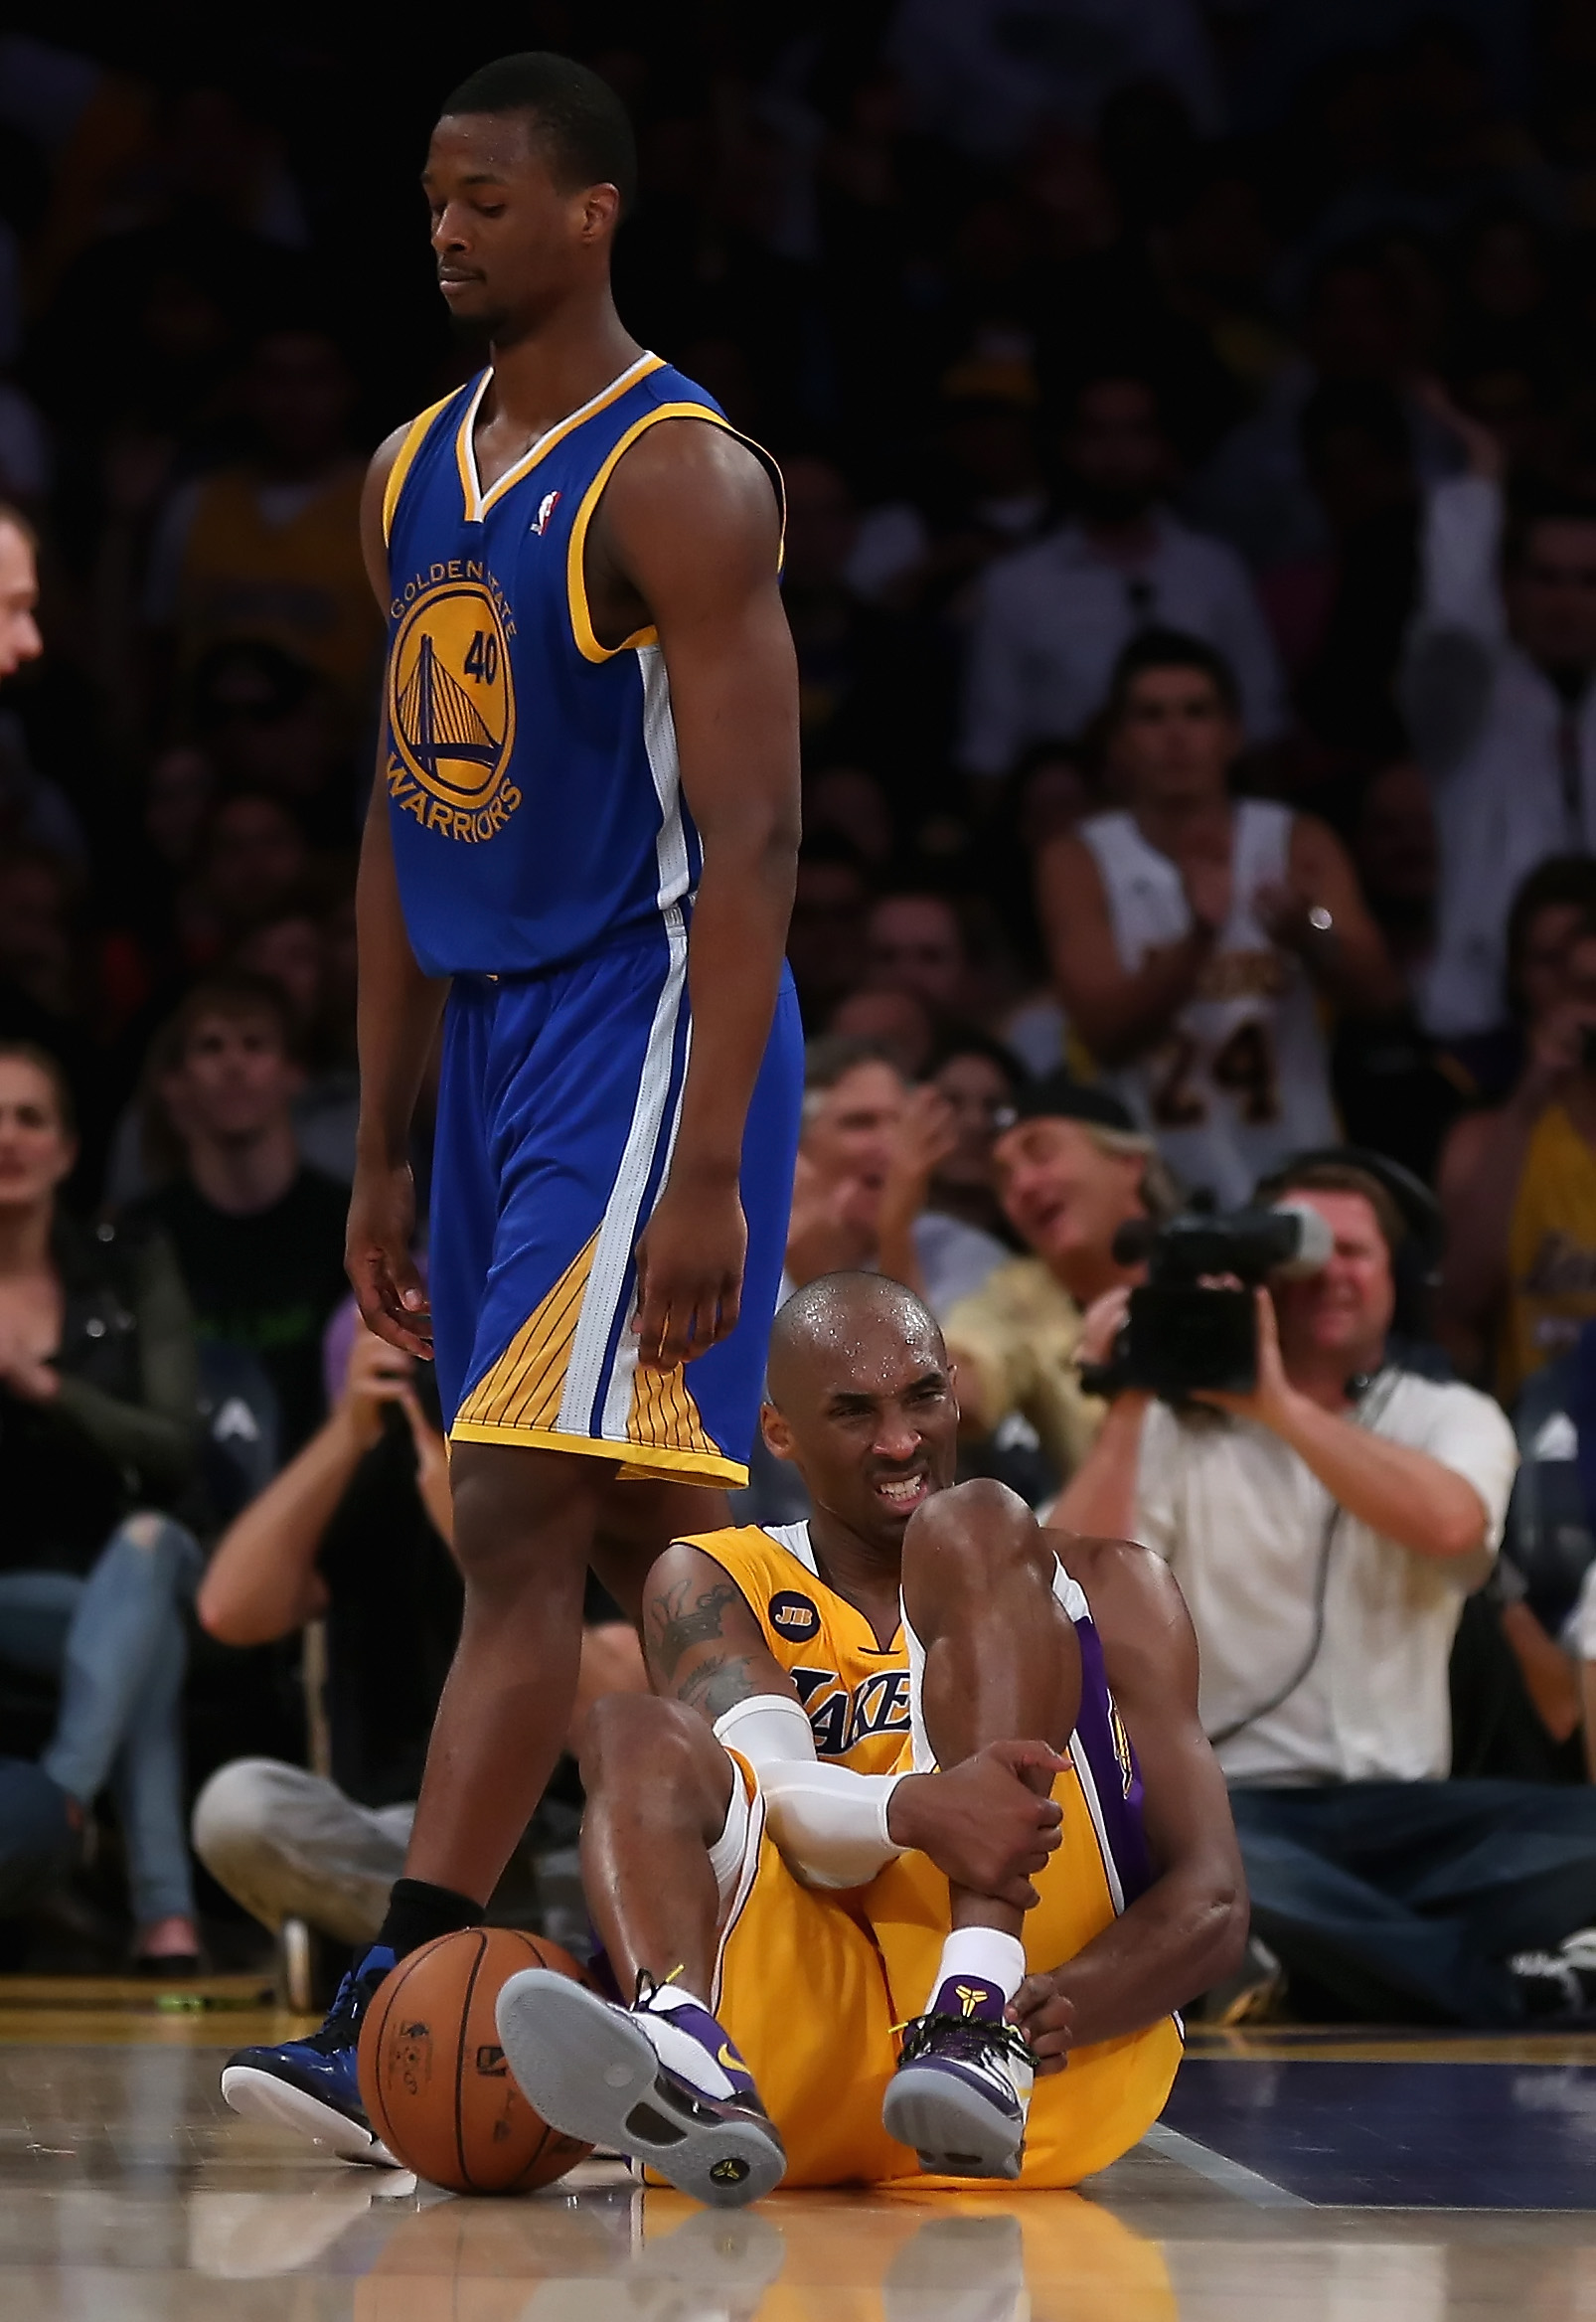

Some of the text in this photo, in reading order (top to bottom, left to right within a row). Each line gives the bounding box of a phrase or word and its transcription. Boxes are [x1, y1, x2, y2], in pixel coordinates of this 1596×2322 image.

[391, 560, 484, 619] GOLDEN
[463, 630, 497, 685] 40
[387, 751, 523, 843] WARRIORS
